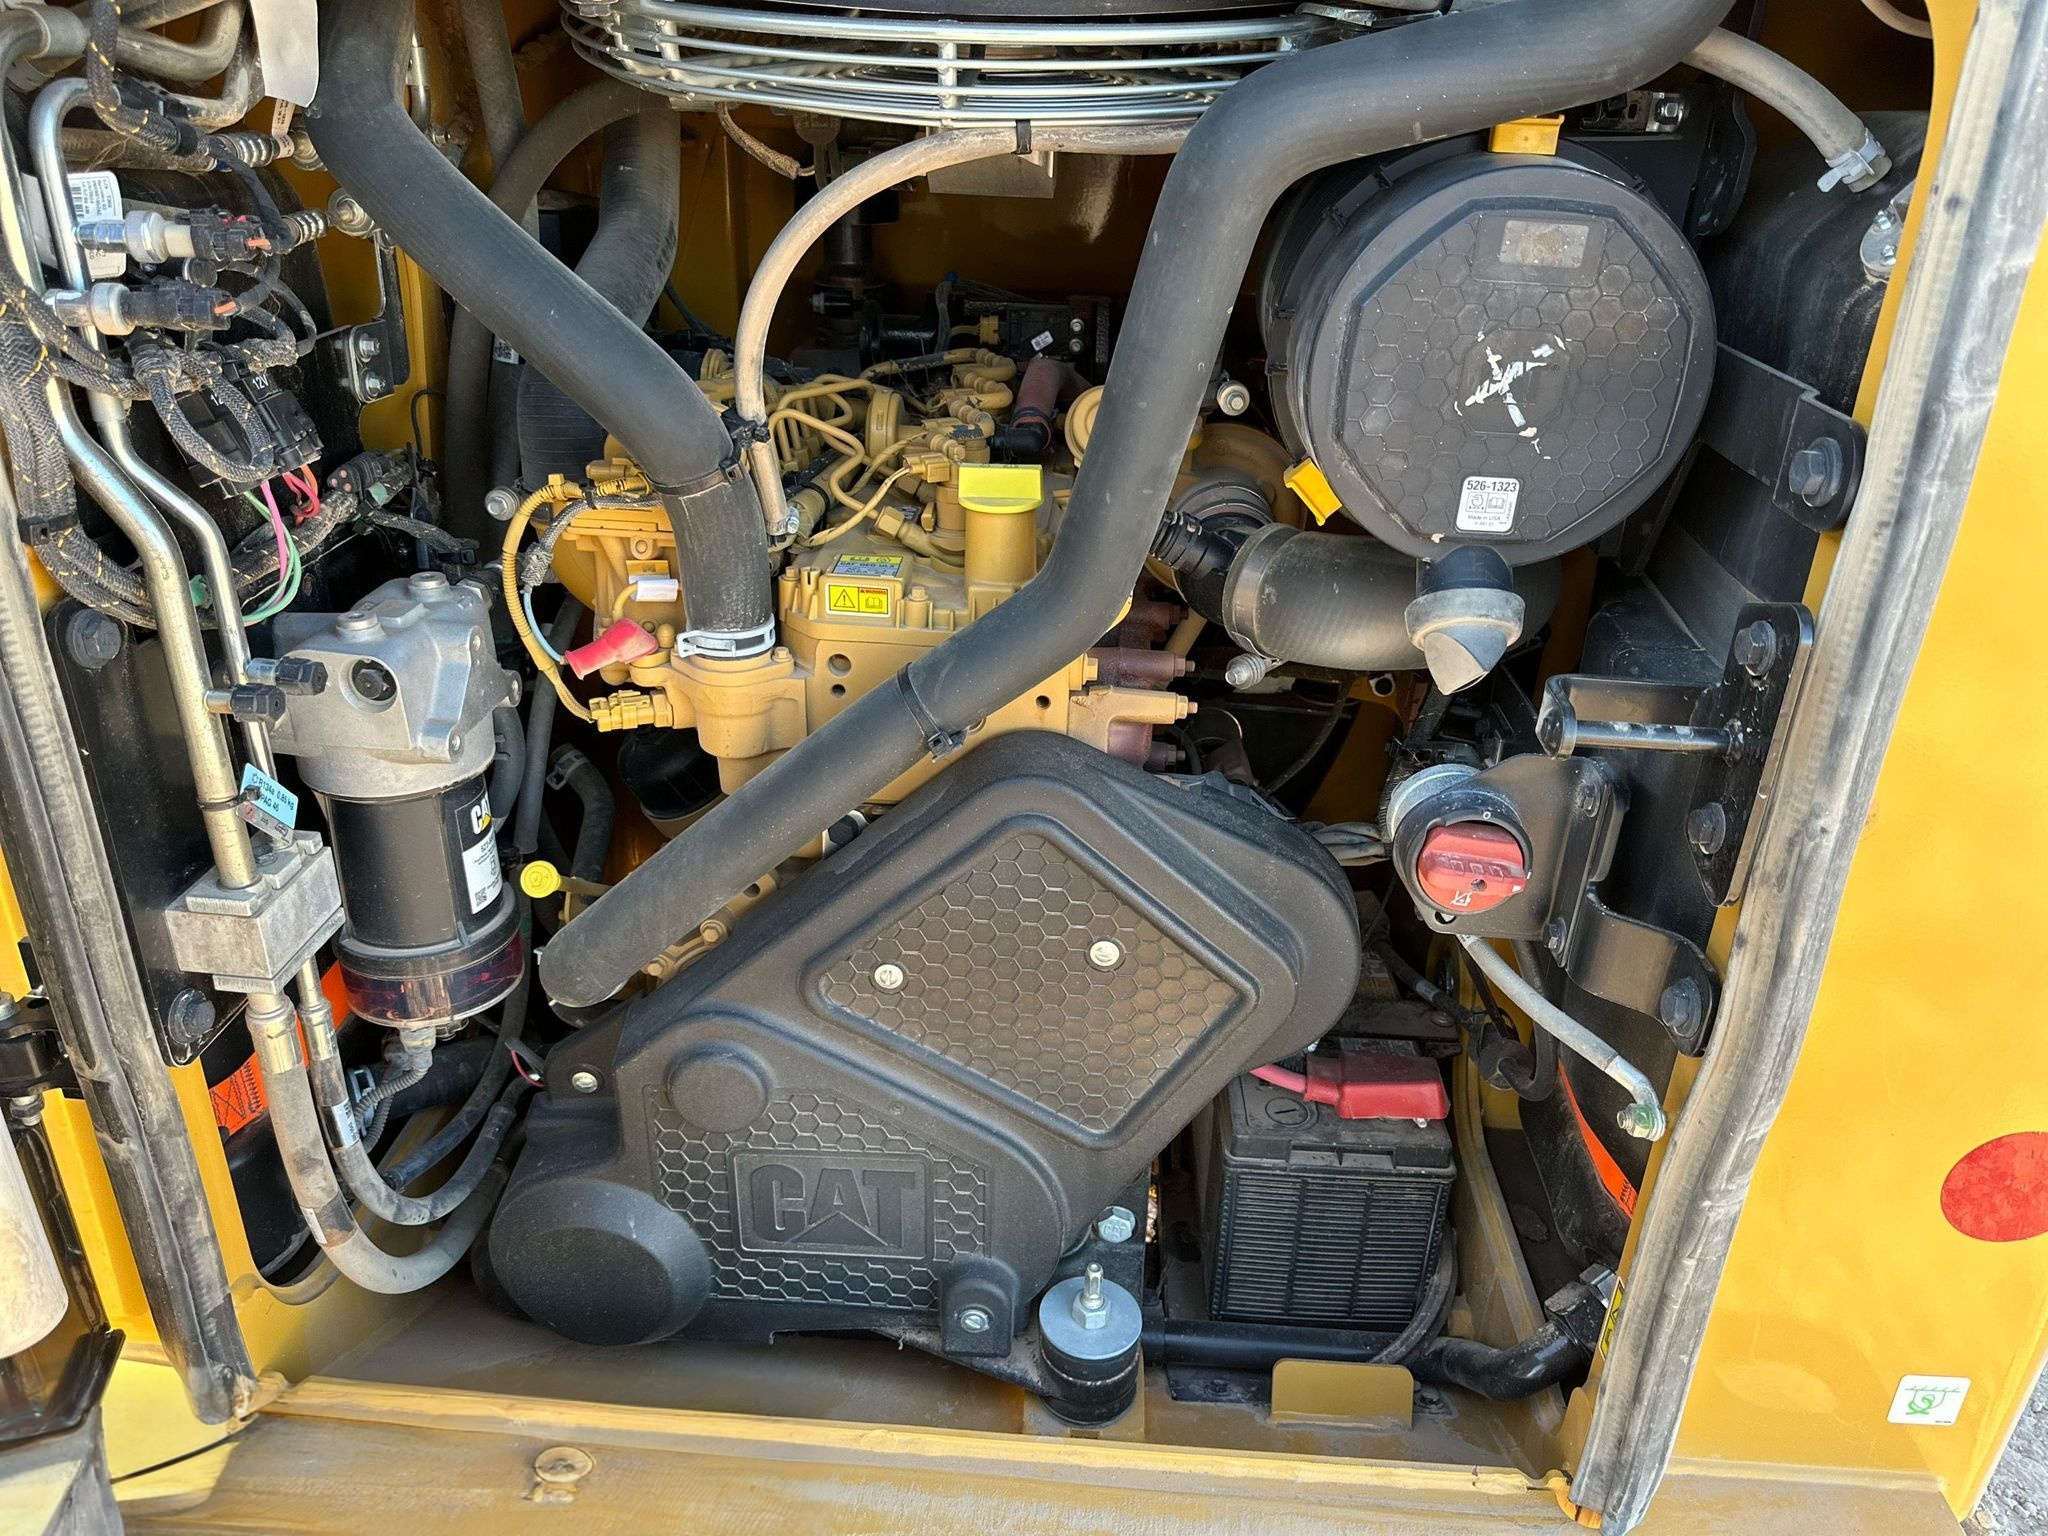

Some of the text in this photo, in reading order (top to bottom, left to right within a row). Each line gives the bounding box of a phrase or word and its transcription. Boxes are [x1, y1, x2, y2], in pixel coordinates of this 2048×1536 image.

[252, 374, 269, 390] 12V
[1466, 480, 1517, 492] 526-1323
[260, 794, 272, 807] PAG
[471, 790, 491, 835] CA
[750, 1163, 916, 1248] CAT
